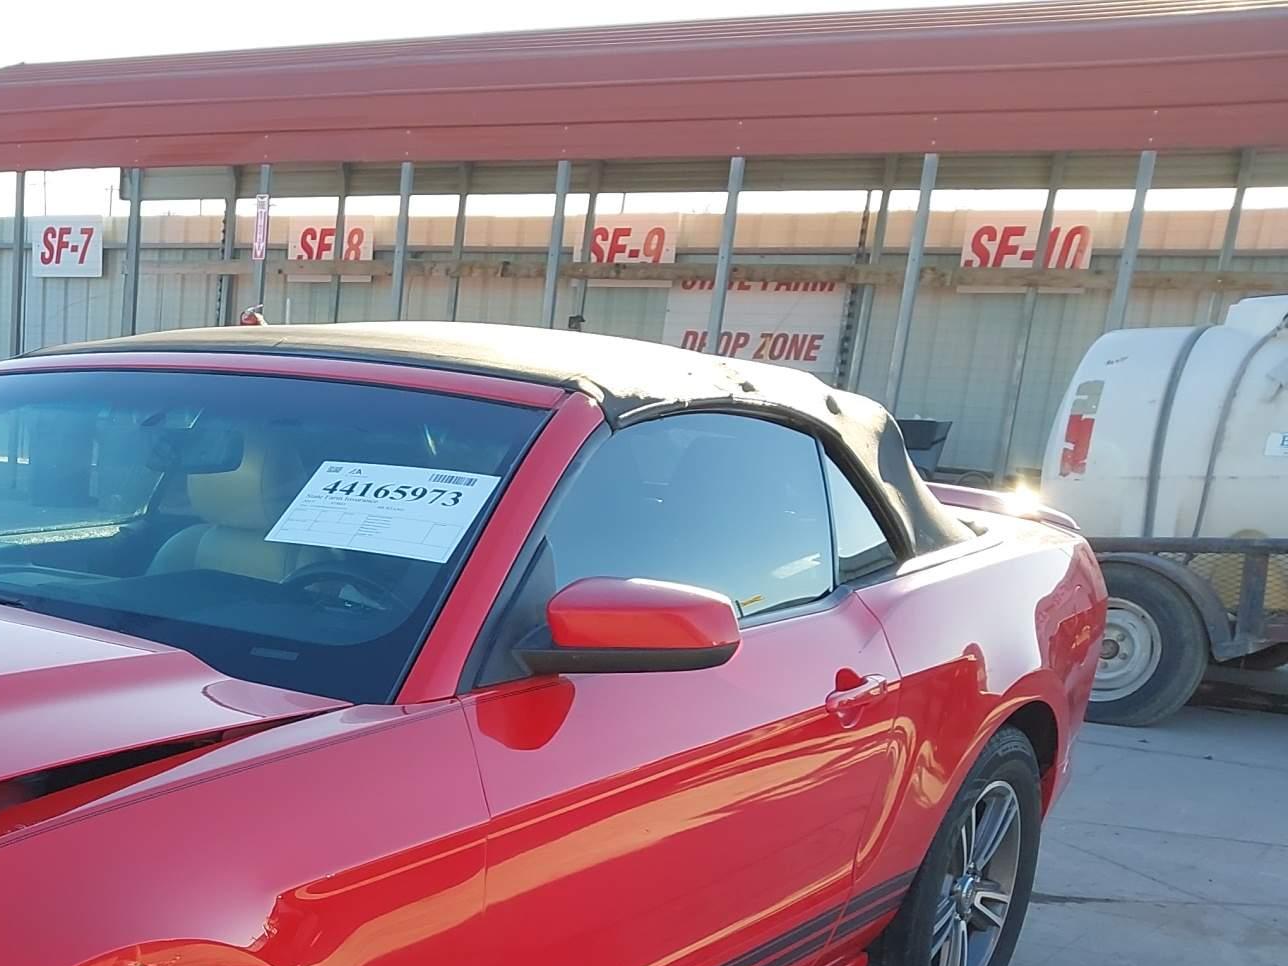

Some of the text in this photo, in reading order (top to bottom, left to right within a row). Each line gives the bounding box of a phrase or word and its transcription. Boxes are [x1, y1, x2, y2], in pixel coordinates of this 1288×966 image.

[40, 226, 94, 265] SF-7
[589, 227, 666, 264] SF-9
[964, 225, 1091, 269] SF-10
[752, 333, 824, 362] ZONE
[322, 479, 463, 507] 44165973
